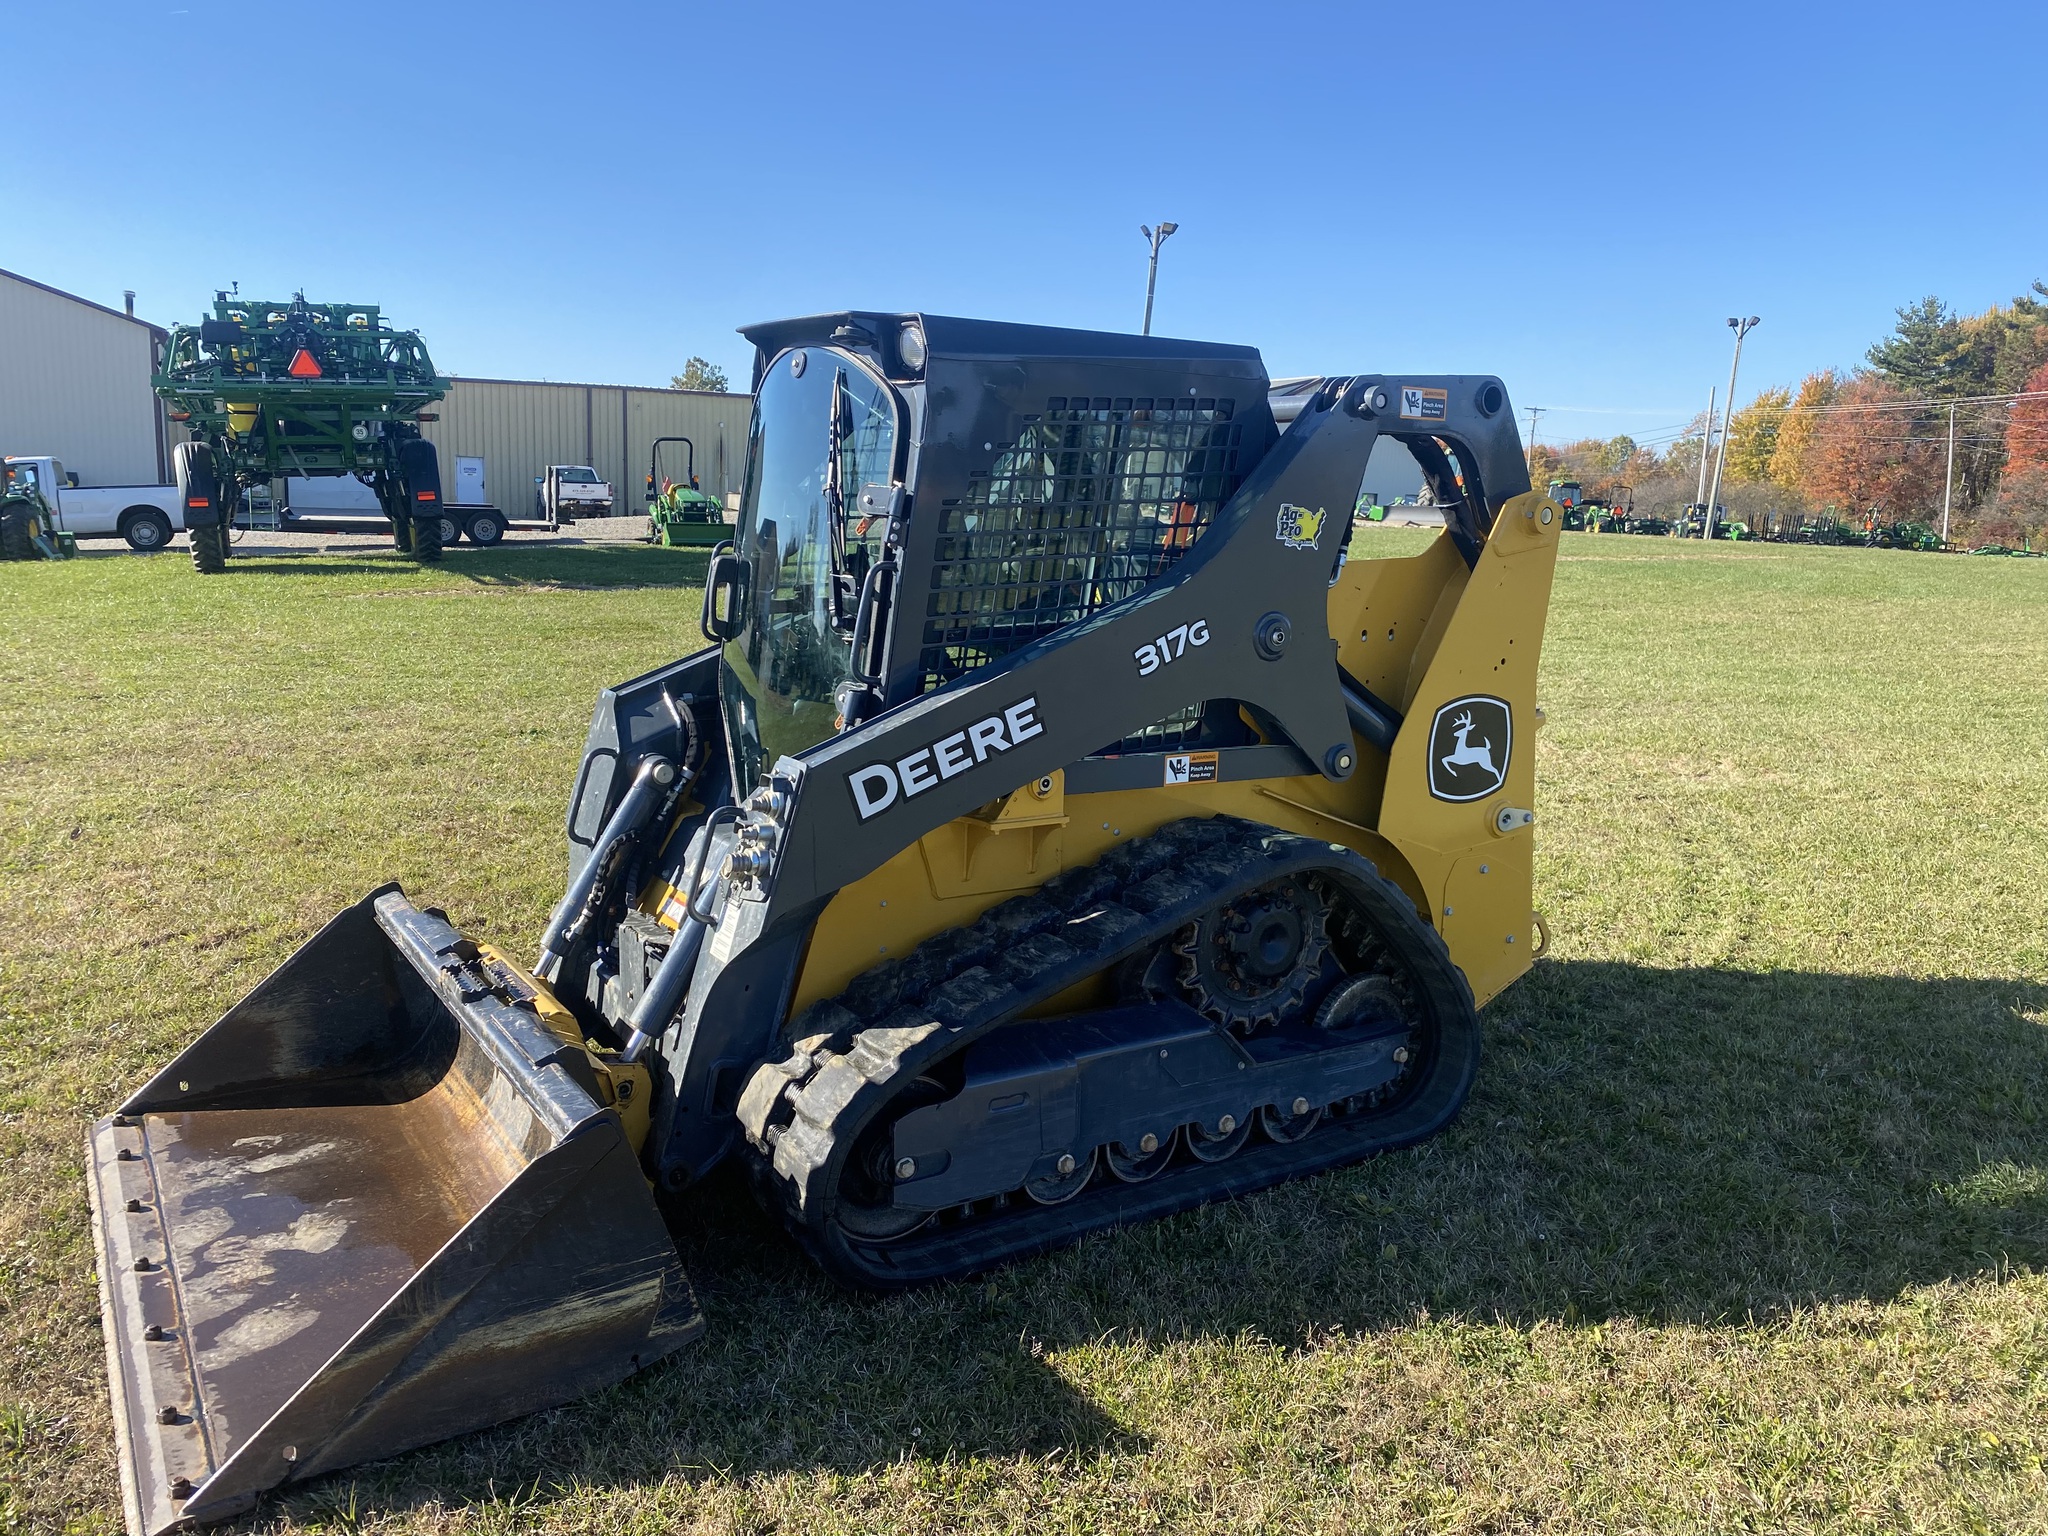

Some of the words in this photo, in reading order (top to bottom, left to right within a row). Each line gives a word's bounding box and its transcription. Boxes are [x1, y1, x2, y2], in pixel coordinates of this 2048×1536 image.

[1279, 522, 1302, 536] Pro
[1281, 506, 1303, 524] Ag-
[1134, 620, 1210, 676] 317G
[848, 697, 1043, 820] DEERE
